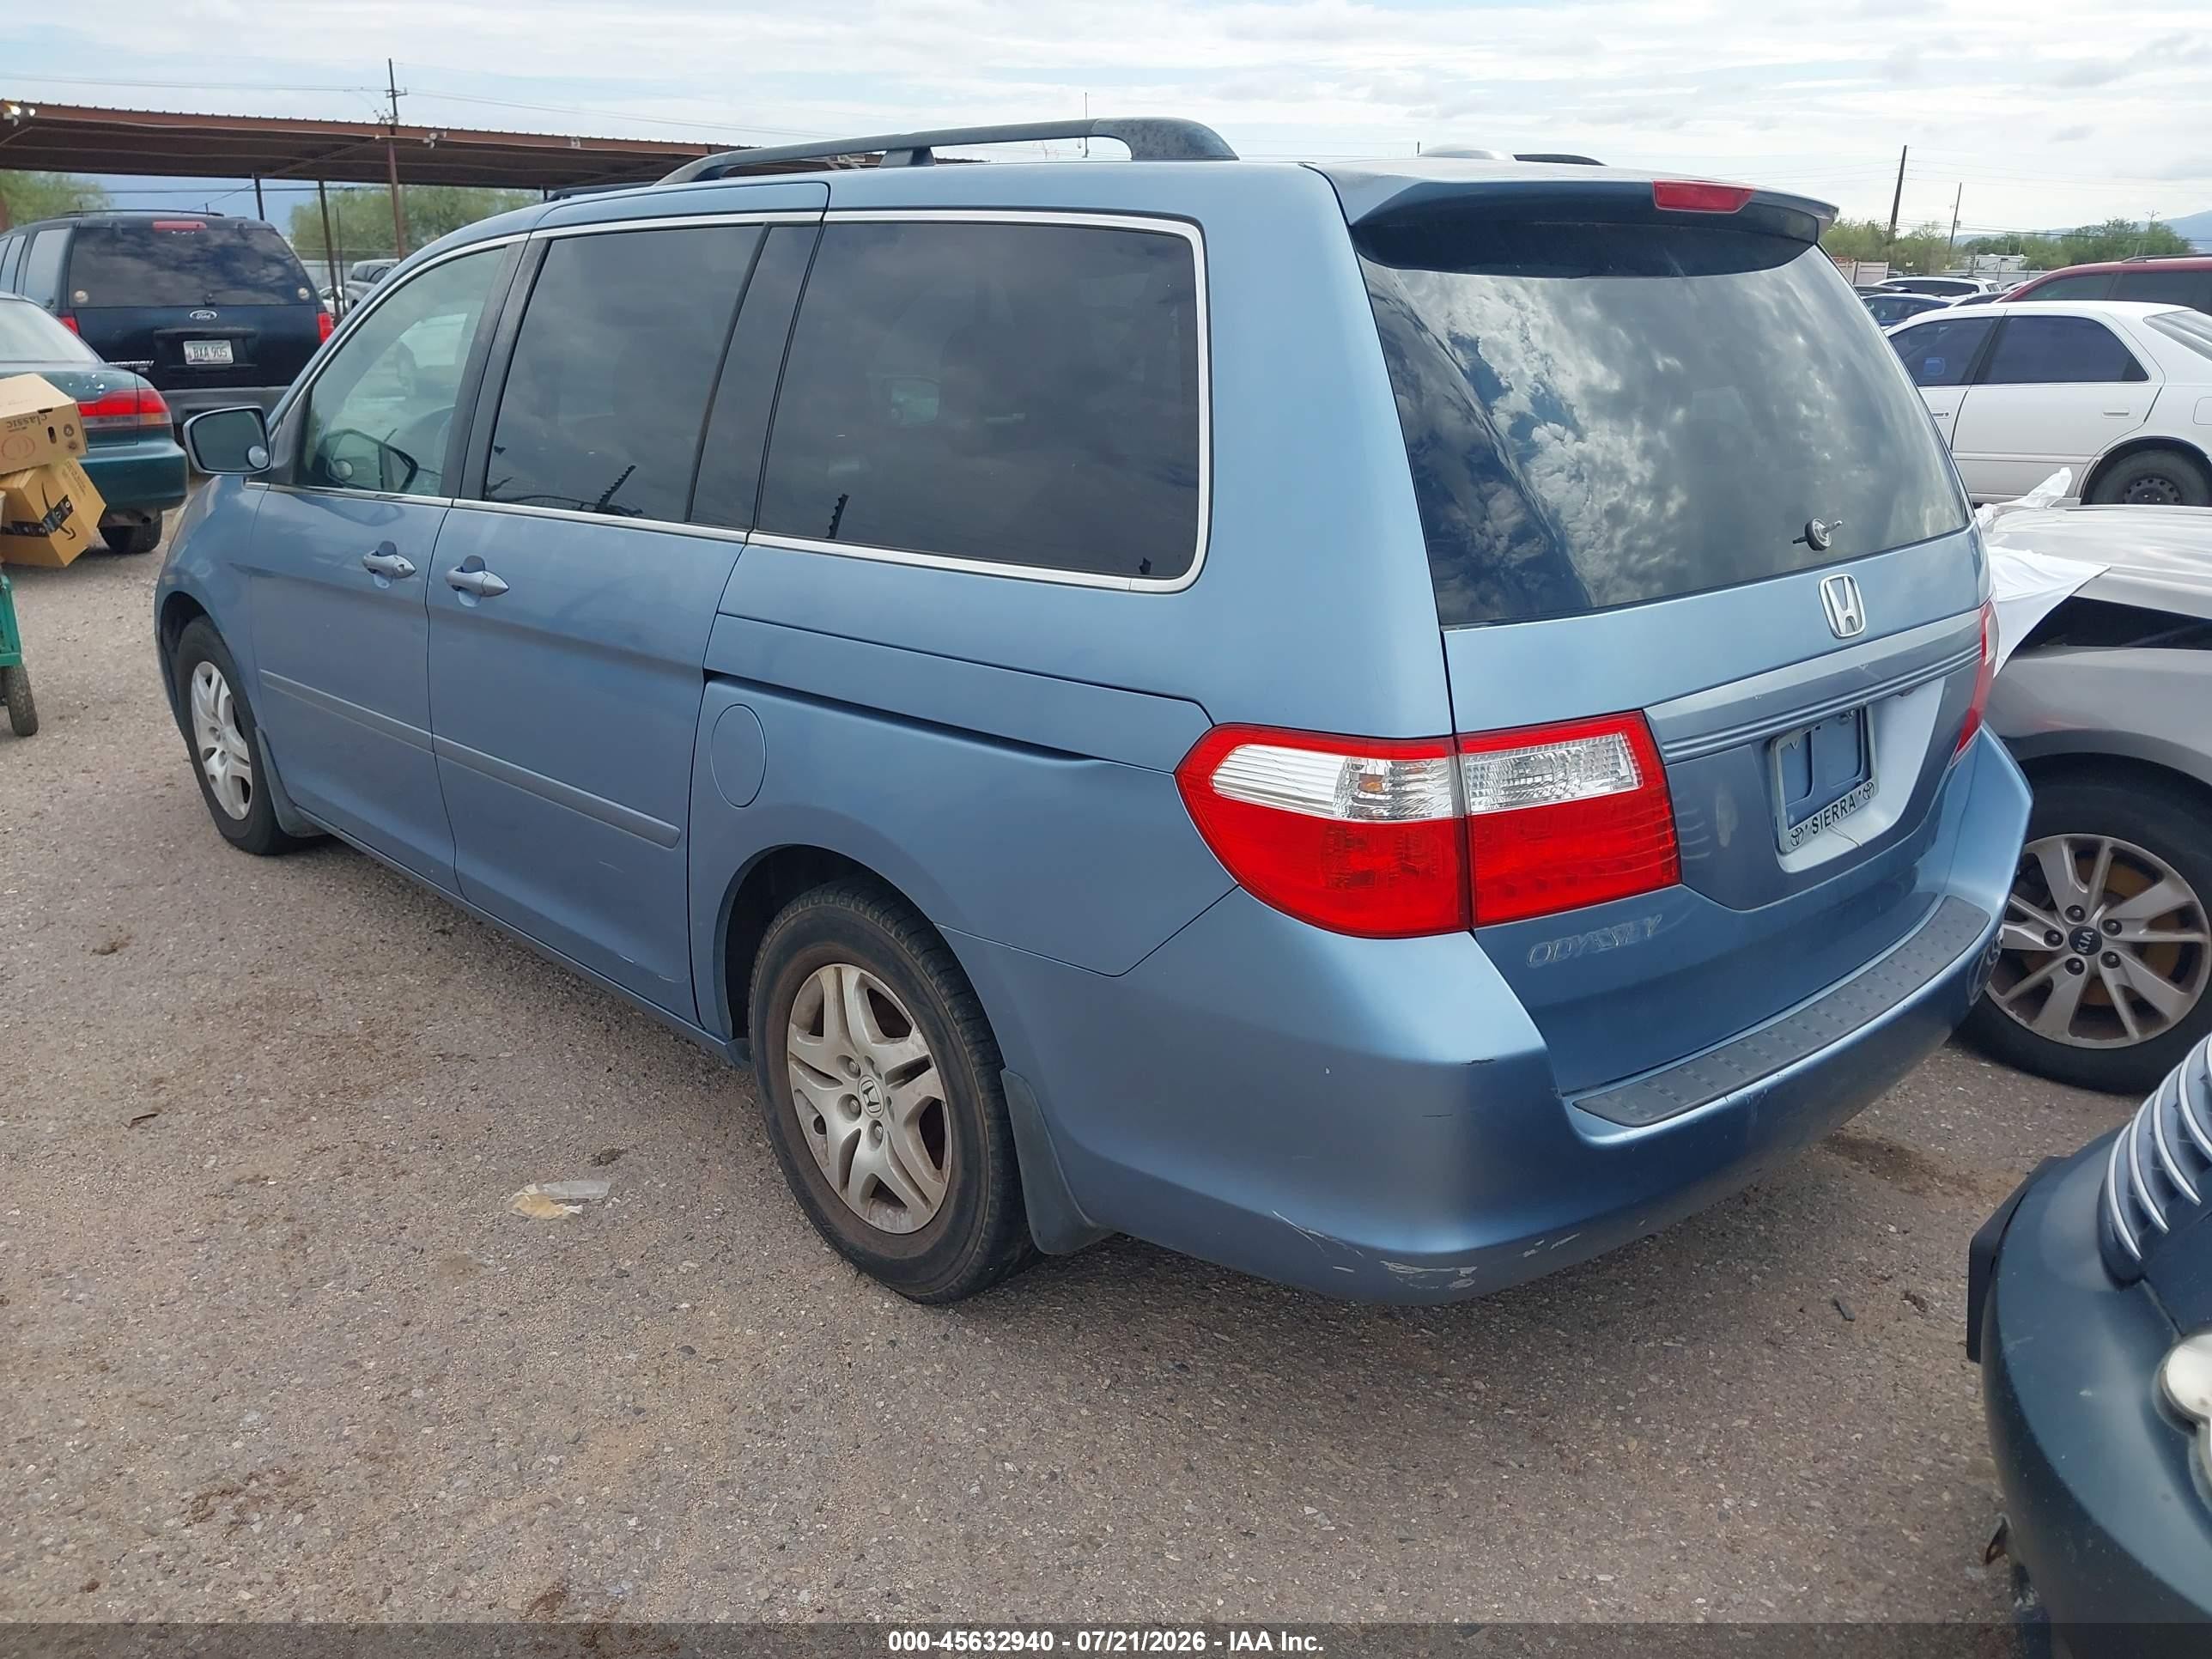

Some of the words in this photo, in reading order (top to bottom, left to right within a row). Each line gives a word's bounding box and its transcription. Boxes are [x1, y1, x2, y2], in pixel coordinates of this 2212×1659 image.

[6, 414, 47, 428] classic
[1811, 793, 1856, 835] SIERRA
[1526, 914, 1663, 969] ODYSSEY
[2076, 932, 2094, 953] KIA
